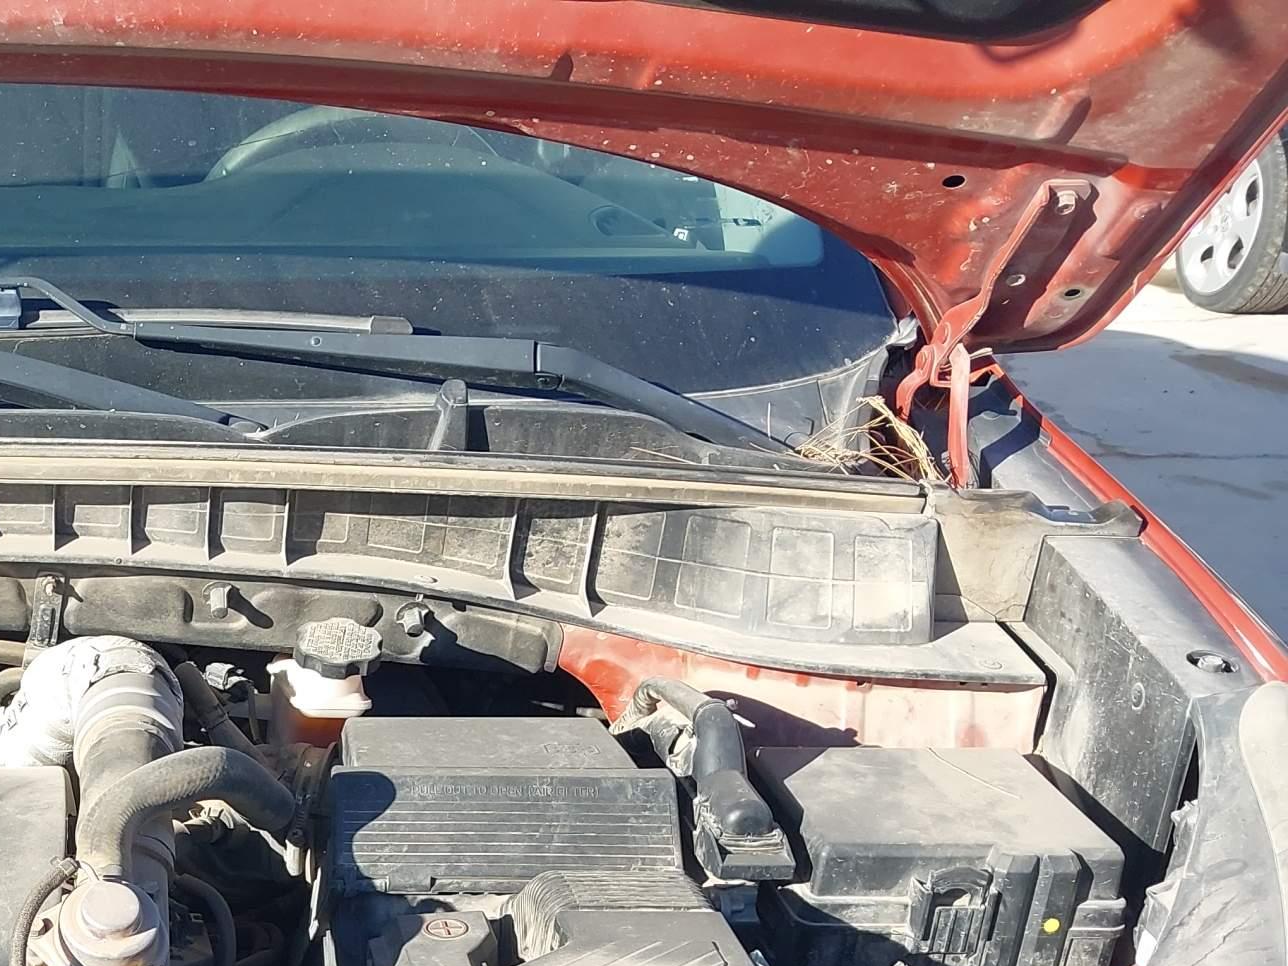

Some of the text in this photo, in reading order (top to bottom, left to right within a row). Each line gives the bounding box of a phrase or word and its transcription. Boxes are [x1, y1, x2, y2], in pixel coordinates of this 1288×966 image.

[472, 784, 487, 796] TO
[490, 784, 523, 797] OPEN
[556, 785, 600, 799] FITER)
